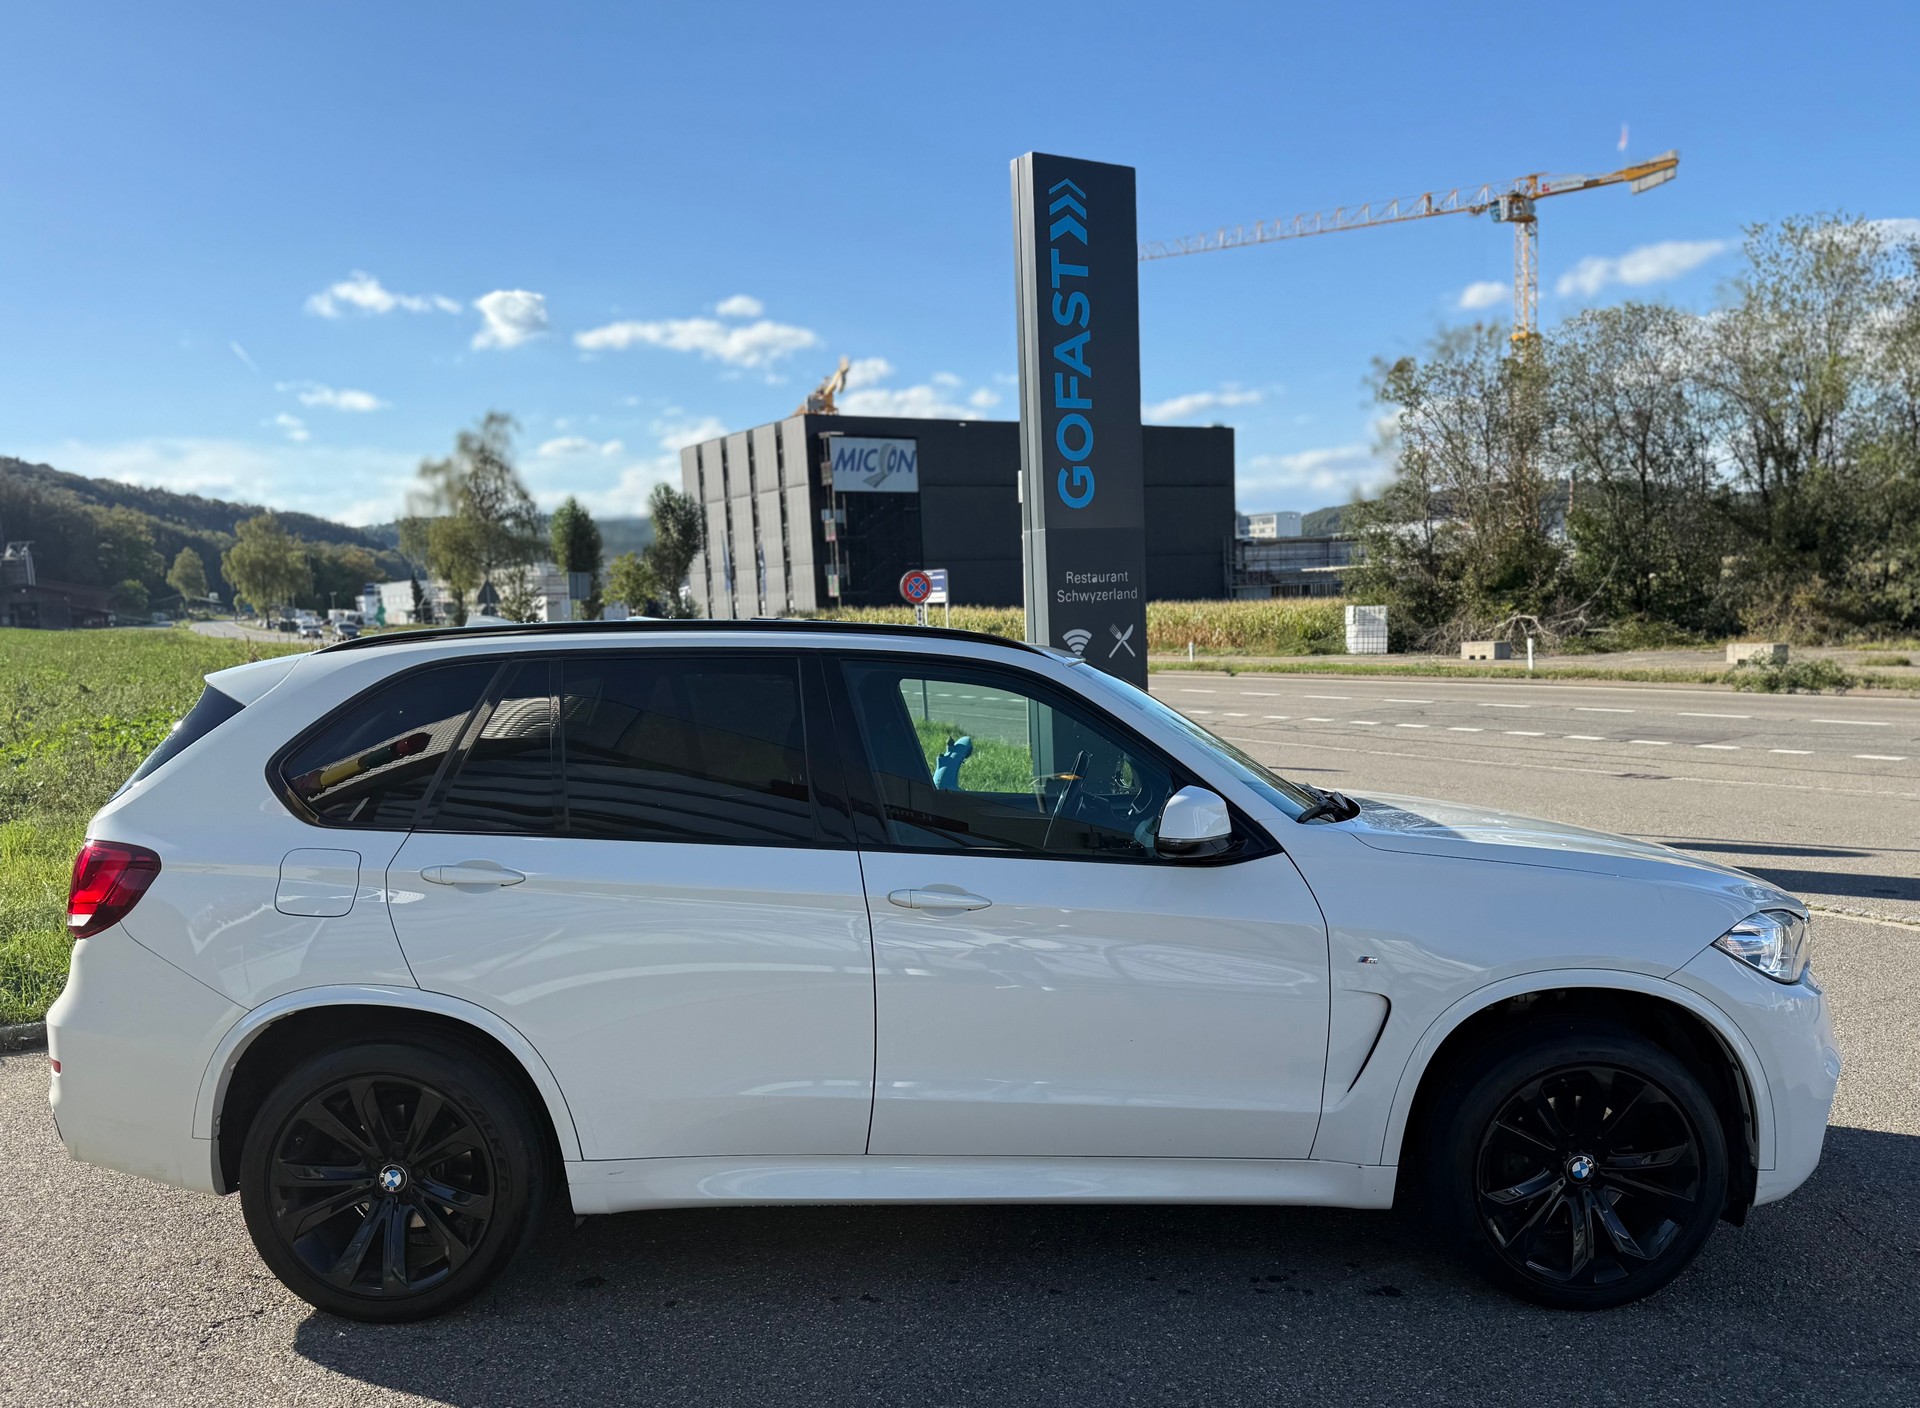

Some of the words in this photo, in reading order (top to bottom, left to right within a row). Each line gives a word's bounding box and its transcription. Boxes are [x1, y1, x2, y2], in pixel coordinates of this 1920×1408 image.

[1051, 248, 1095, 510] GOFAST
[833, 446, 917, 474] MICON
[1066, 571, 1128, 584] Restaurant
[1057, 587, 1138, 604] Schwyzerland
